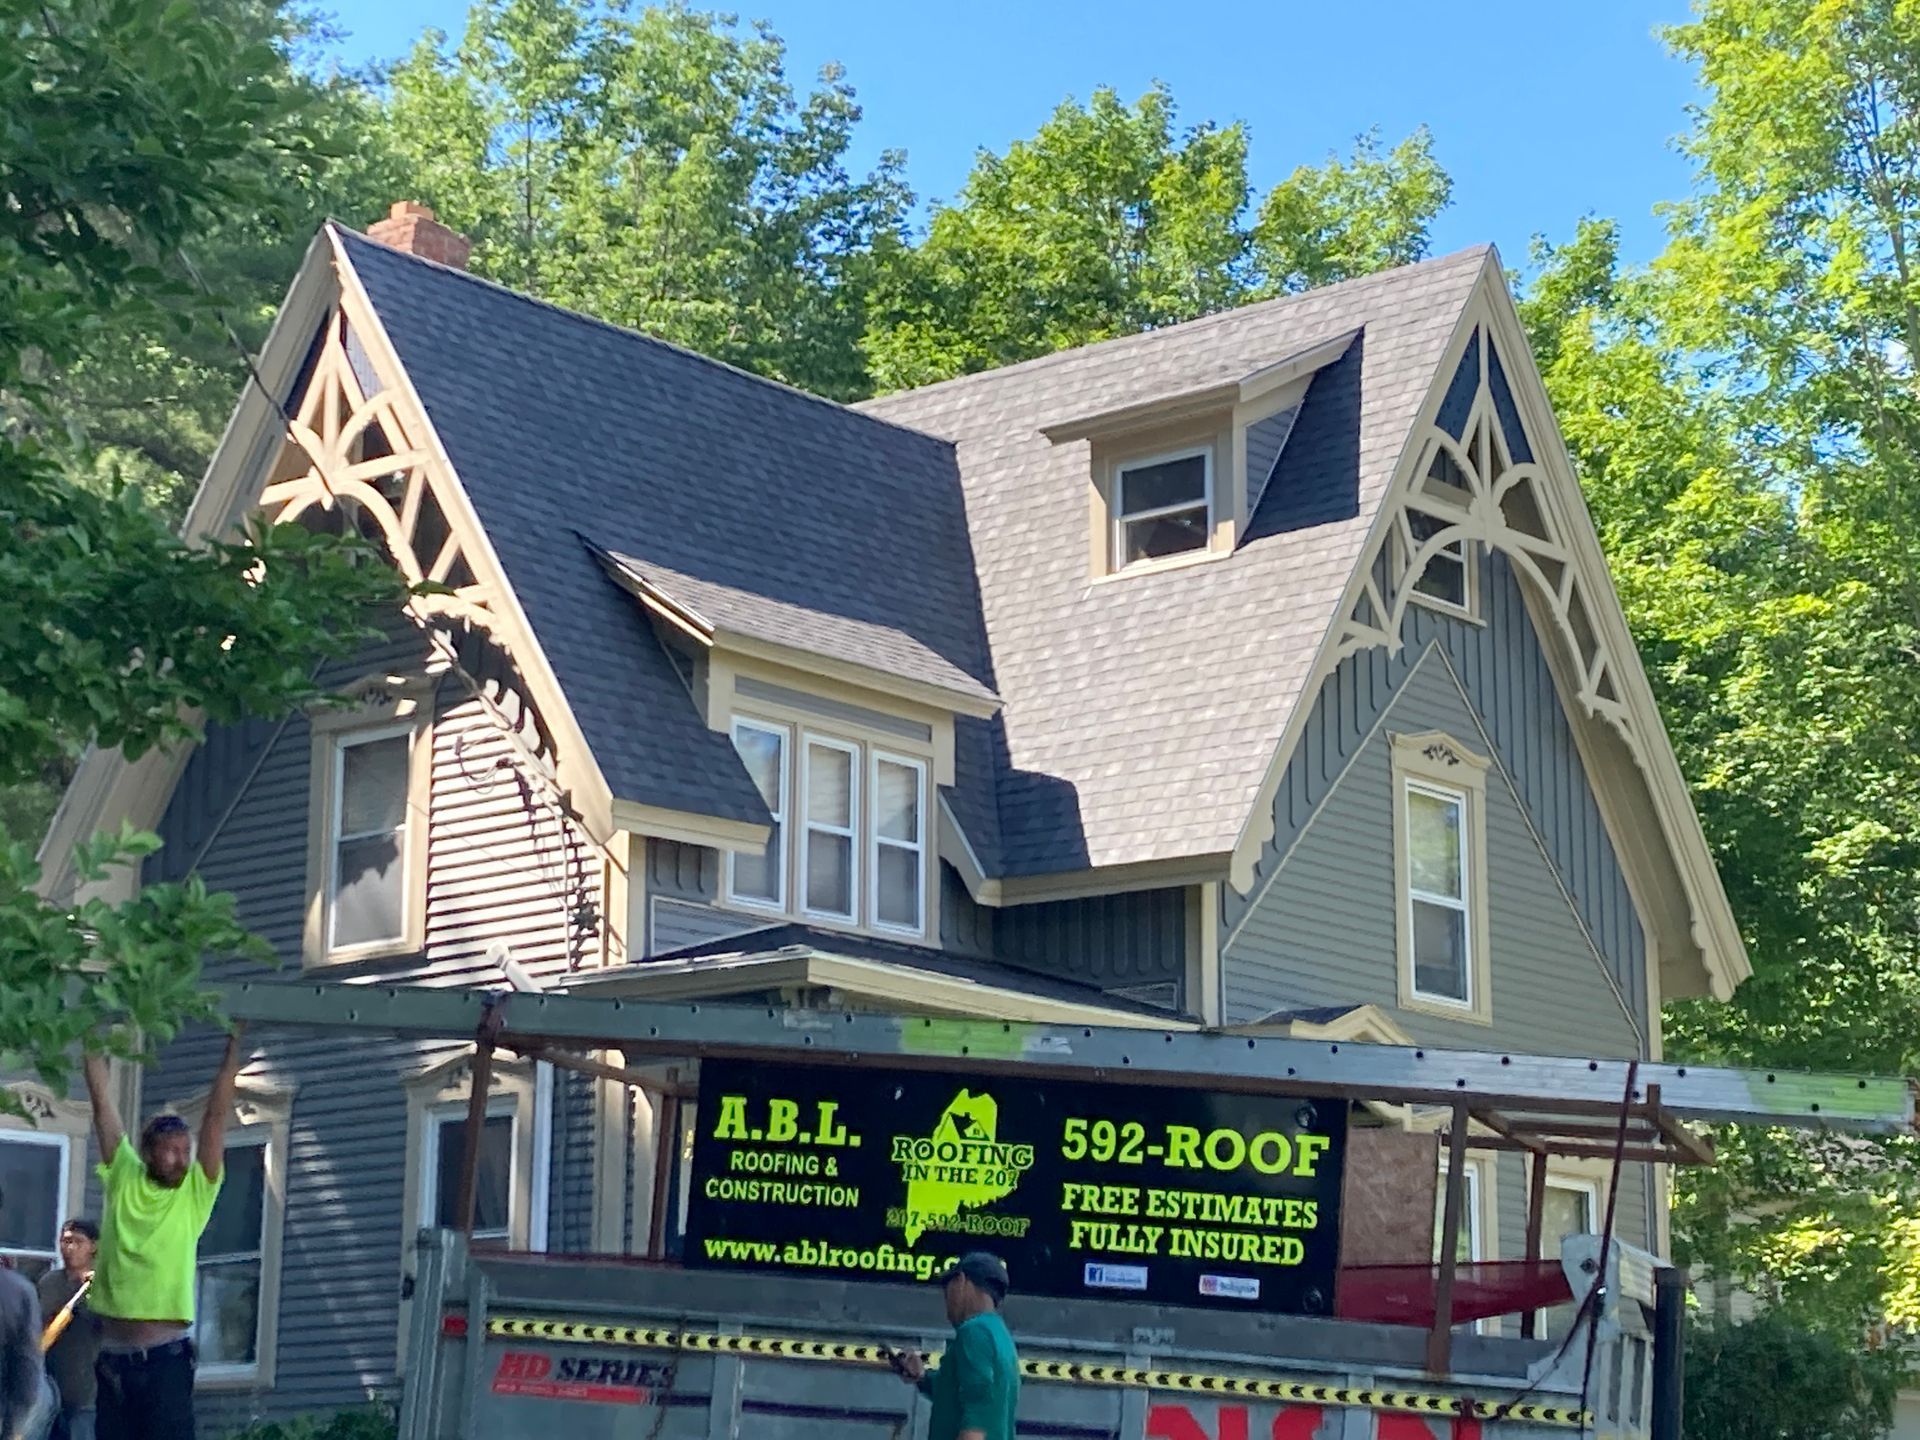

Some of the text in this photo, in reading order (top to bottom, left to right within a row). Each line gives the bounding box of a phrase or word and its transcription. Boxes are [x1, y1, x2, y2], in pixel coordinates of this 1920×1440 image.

[713, 1096, 861, 1147] A.B.L.
[731, 1151, 838, 1177] ROOFING &
[892, 1137, 1033, 1169] ROOFING
[1062, 1119, 1330, 1177] 592-ROOF
[705, 1178, 859, 1208] CONSTRUCTION
[903, 1163, 1019, 1188] IN THE 207
[1061, 1182, 1318, 1229] FREE ESTIMATES
[704, 1239, 1006, 1280] www.ablroofing.c
[1069, 1220, 1304, 1265] FULLY INSURED
[499, 1353, 675, 1388] HD SERIES
